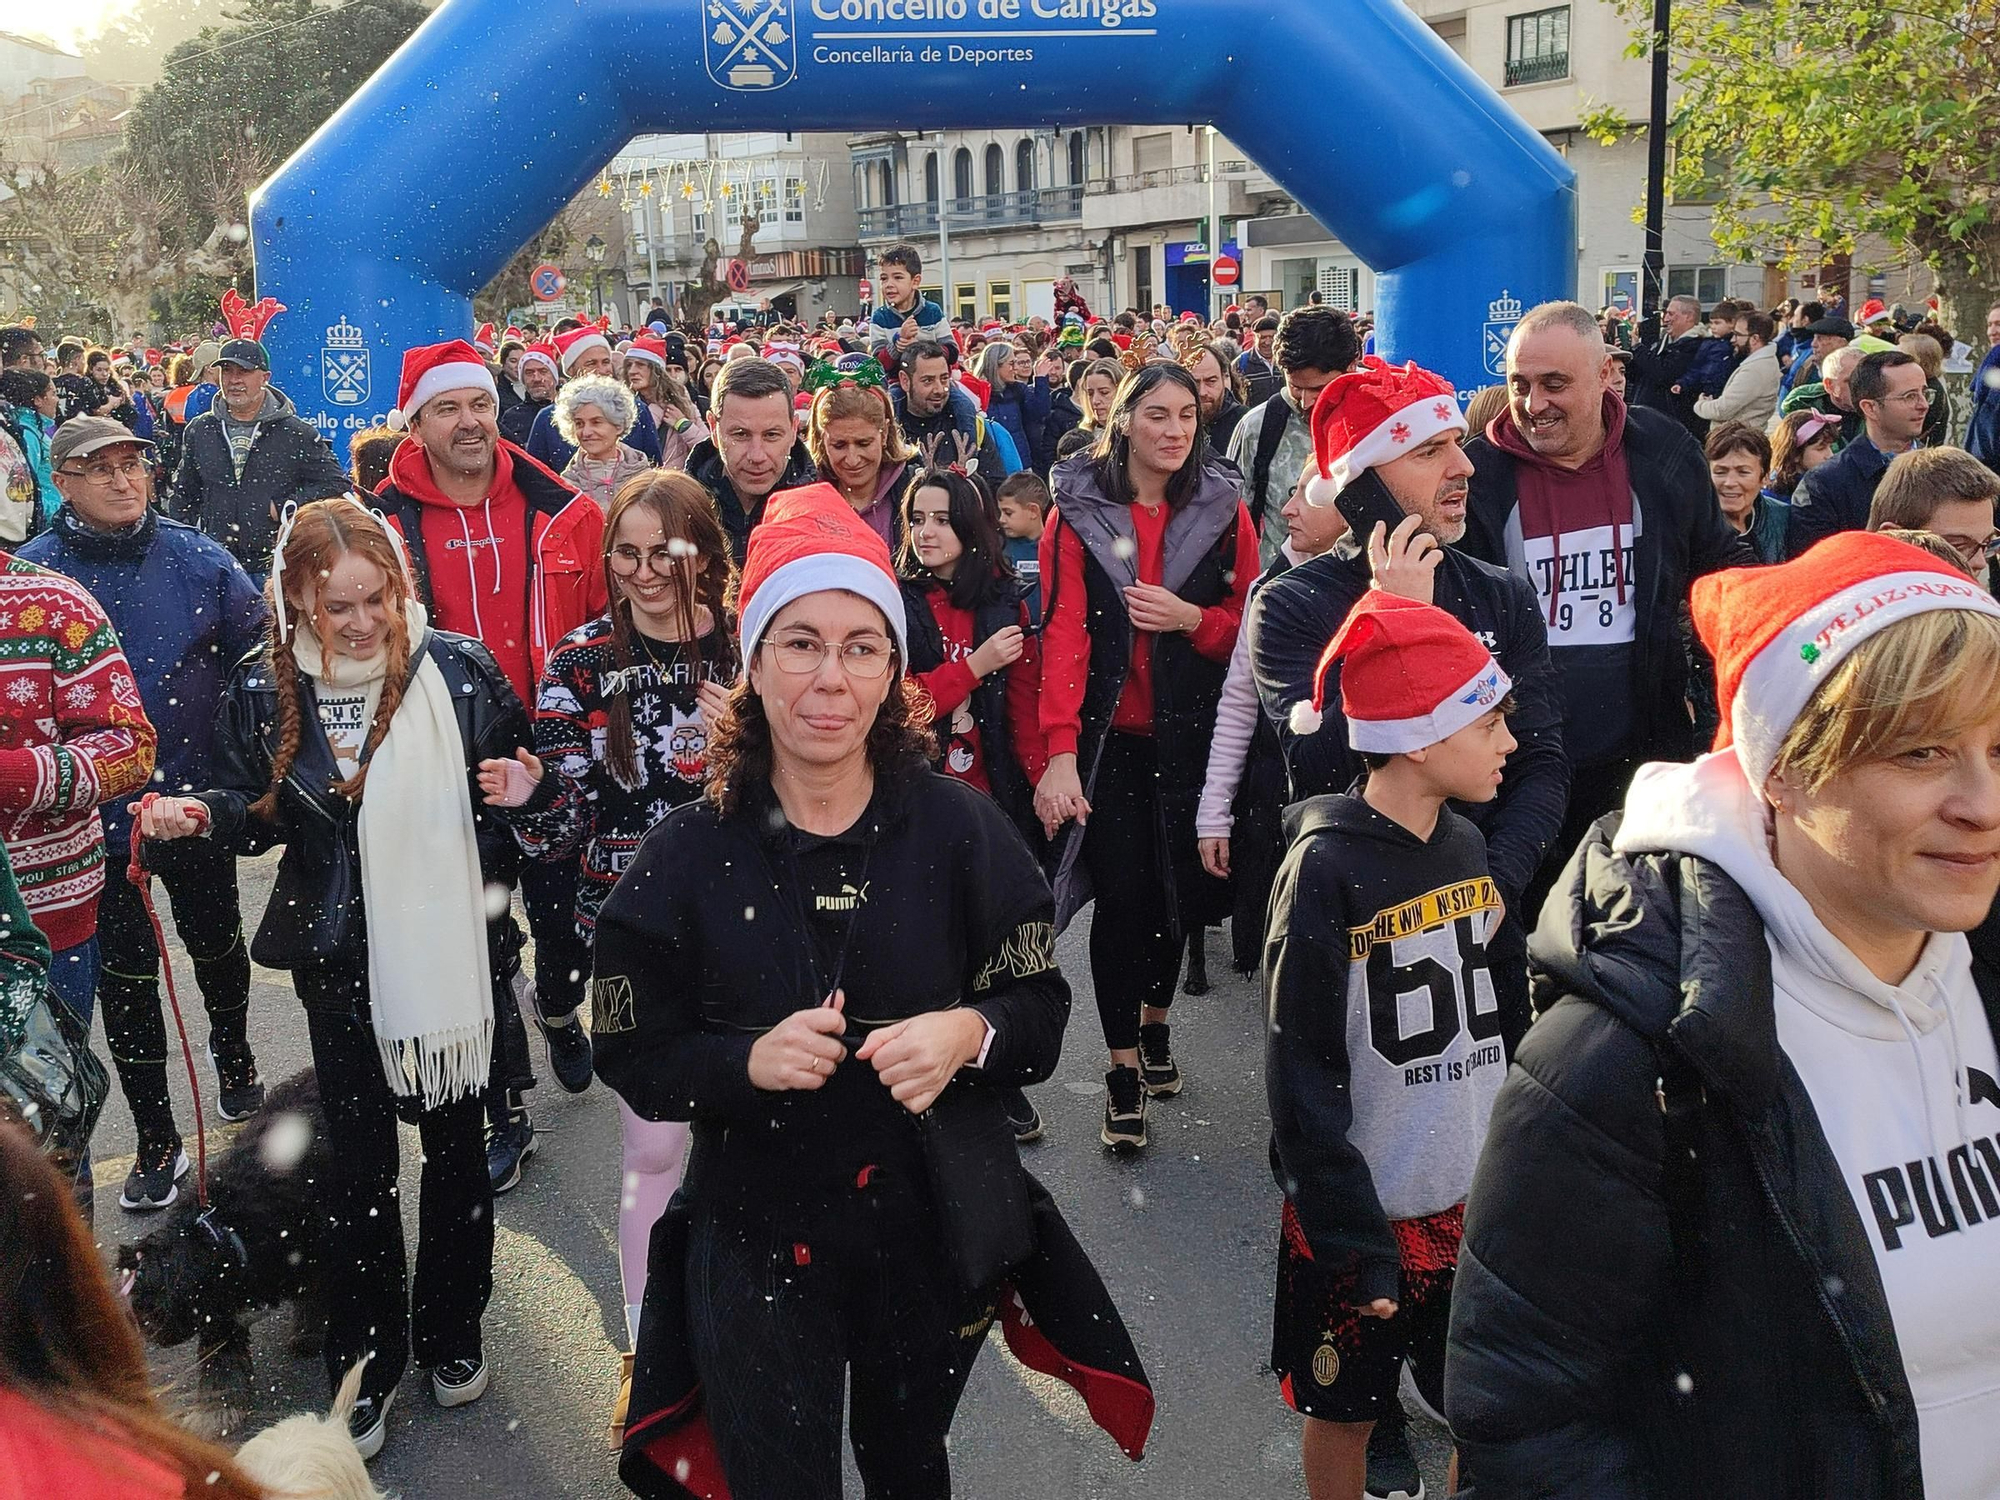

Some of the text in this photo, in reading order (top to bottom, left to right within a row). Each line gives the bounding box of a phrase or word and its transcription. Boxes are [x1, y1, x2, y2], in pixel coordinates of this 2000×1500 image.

[812, 0, 1157, 27] Concello de Cangas
[813, 45, 1033, 67] Concellaría de Deportes
[343, 414, 366, 429] de
[1559, 600, 1613, 631] 9 8
[57, 751, 72, 792] FORCE
[16, 871, 44, 886] YOU
[1404, 1064, 1442, 1087] REST
[1447, 1062, 1463, 1082] IS
[1861, 1132, 2000, 1252] PUM
